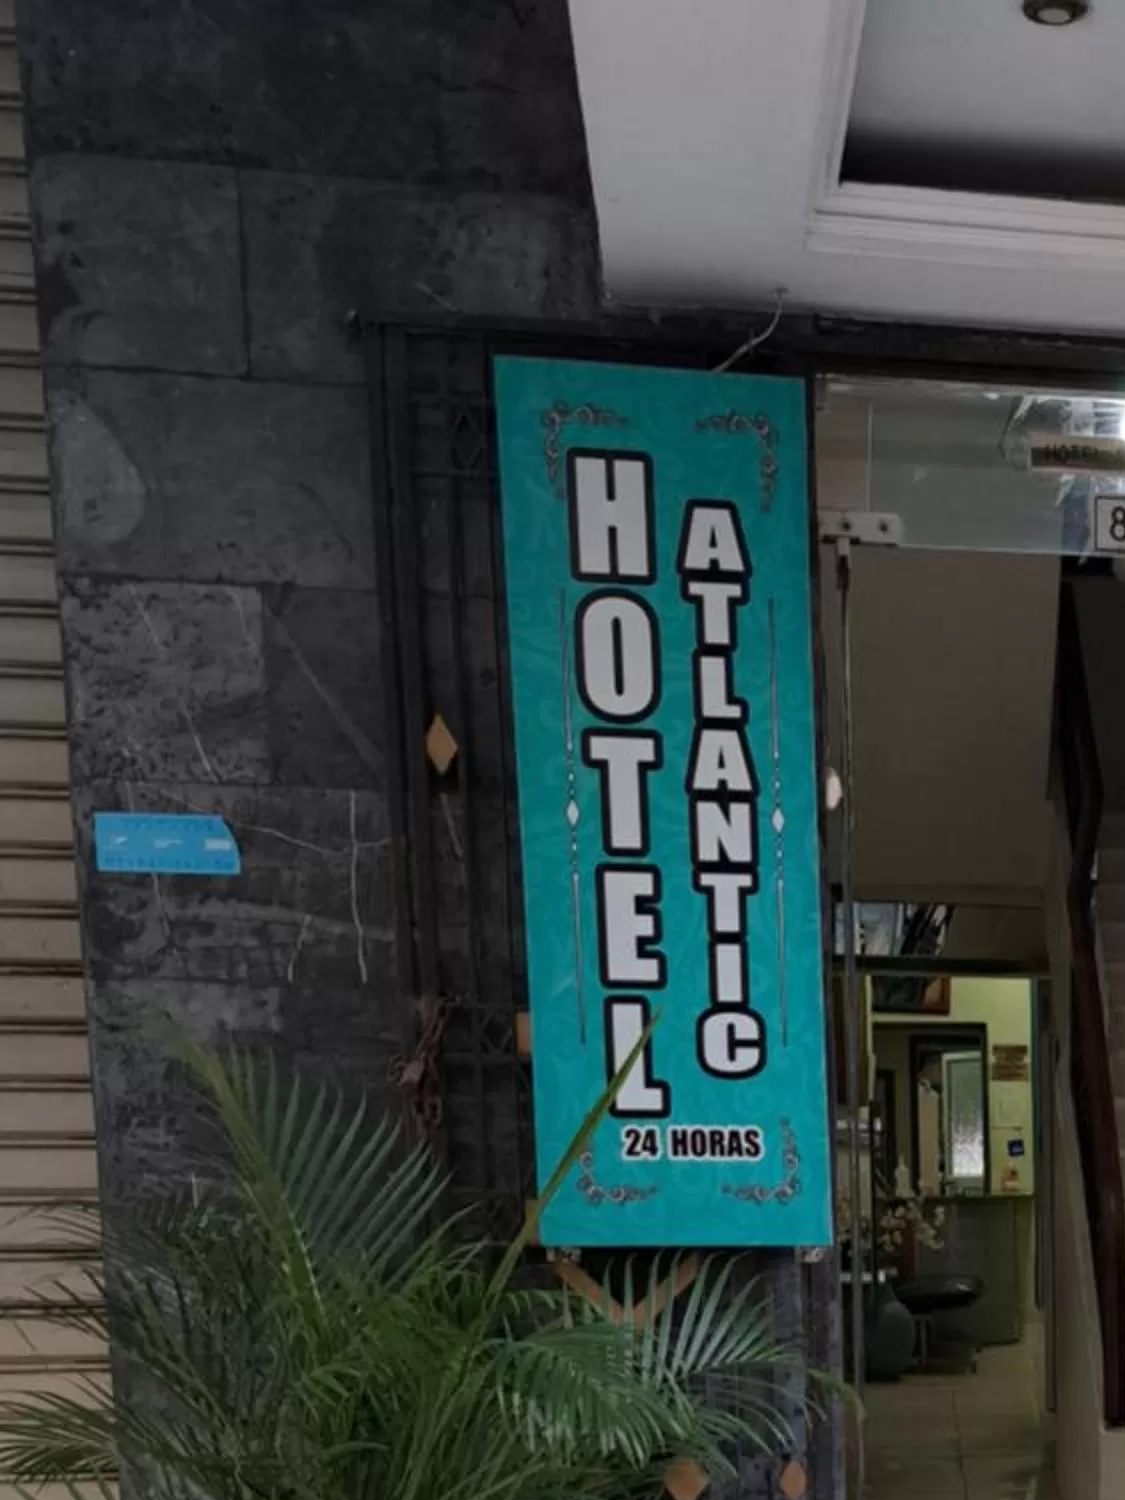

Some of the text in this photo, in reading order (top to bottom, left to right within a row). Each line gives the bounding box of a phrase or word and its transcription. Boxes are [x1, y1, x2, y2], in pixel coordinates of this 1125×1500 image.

[567, 449, 669, 1117] HOTEL
[678, 501, 766, 1077] ATLANTIC
[623, 1127, 763, 1158] 24 HORAS
